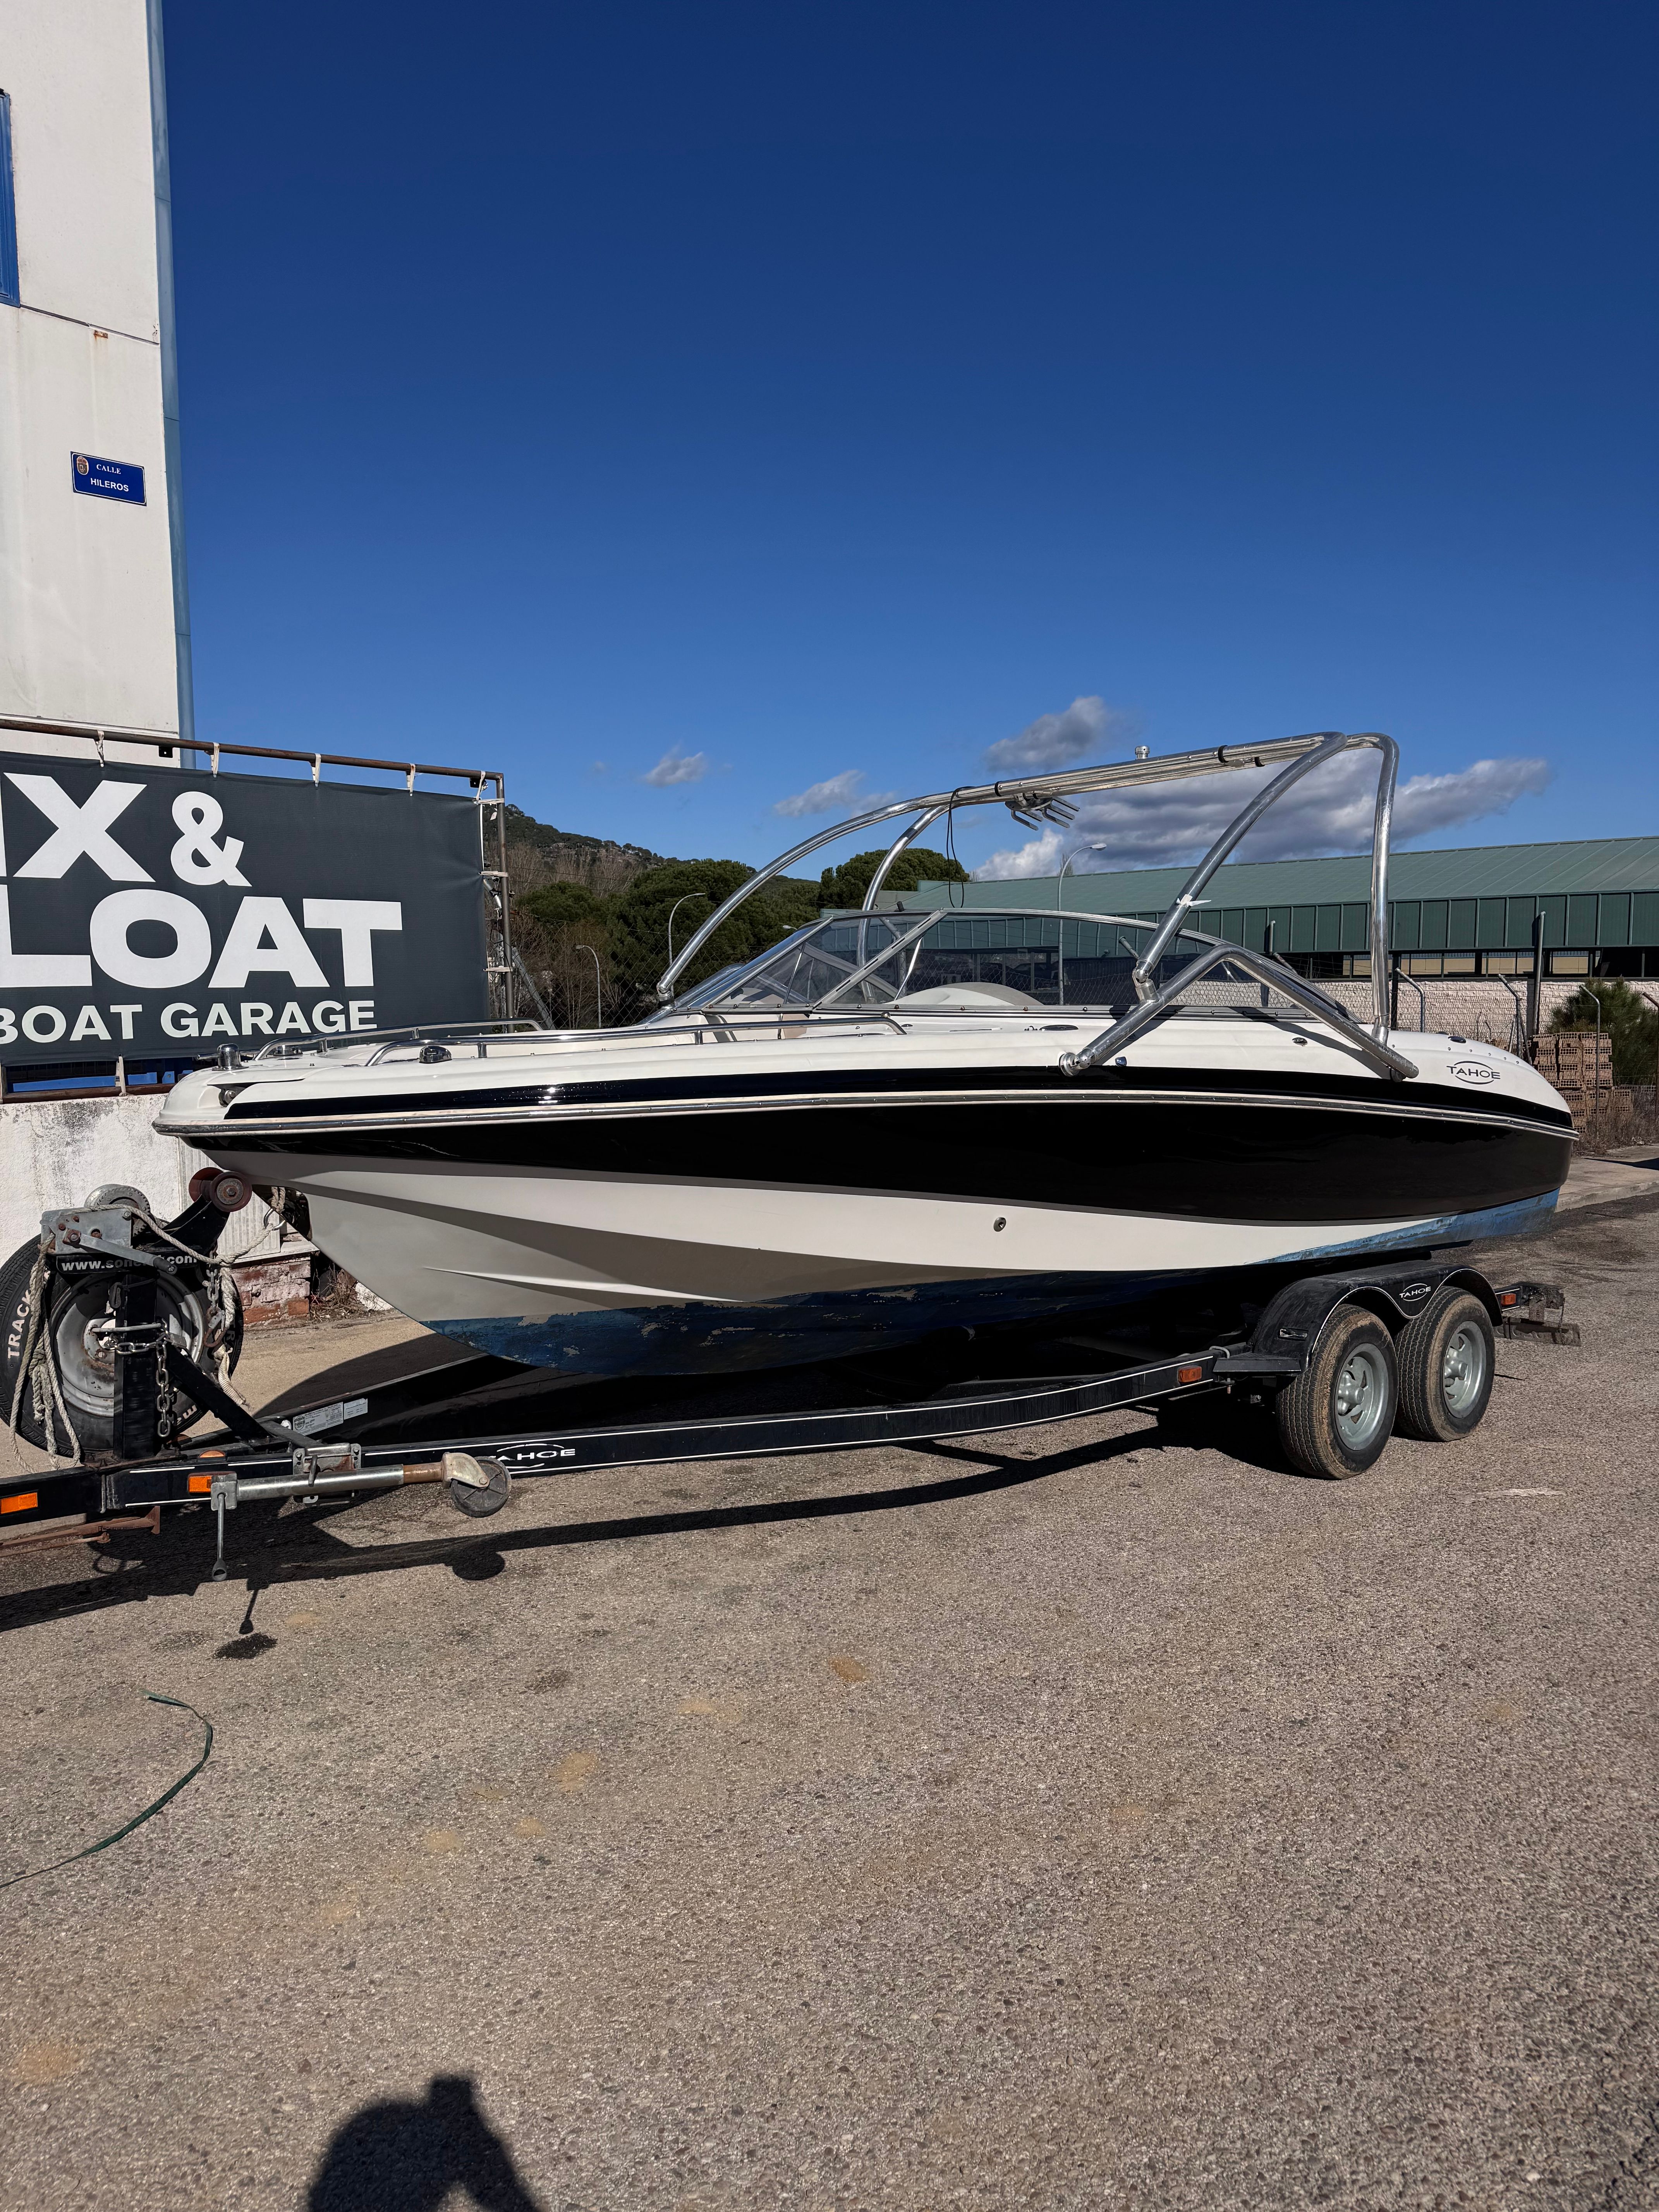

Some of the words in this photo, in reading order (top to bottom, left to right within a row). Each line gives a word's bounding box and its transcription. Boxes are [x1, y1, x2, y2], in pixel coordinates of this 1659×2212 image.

[96, 464, 121, 474] CALLE
[90, 477, 129, 492] HILEROS
[0, 772, 156, 882] X
[170, 791, 252, 887] &
[160, 1000, 378, 1038] GARAGE
[1446, 1066, 1501, 1080] TAHOE
[1399, 1286, 1431, 1298] TAHOE
[489, 1448, 575, 1461] AHOE
